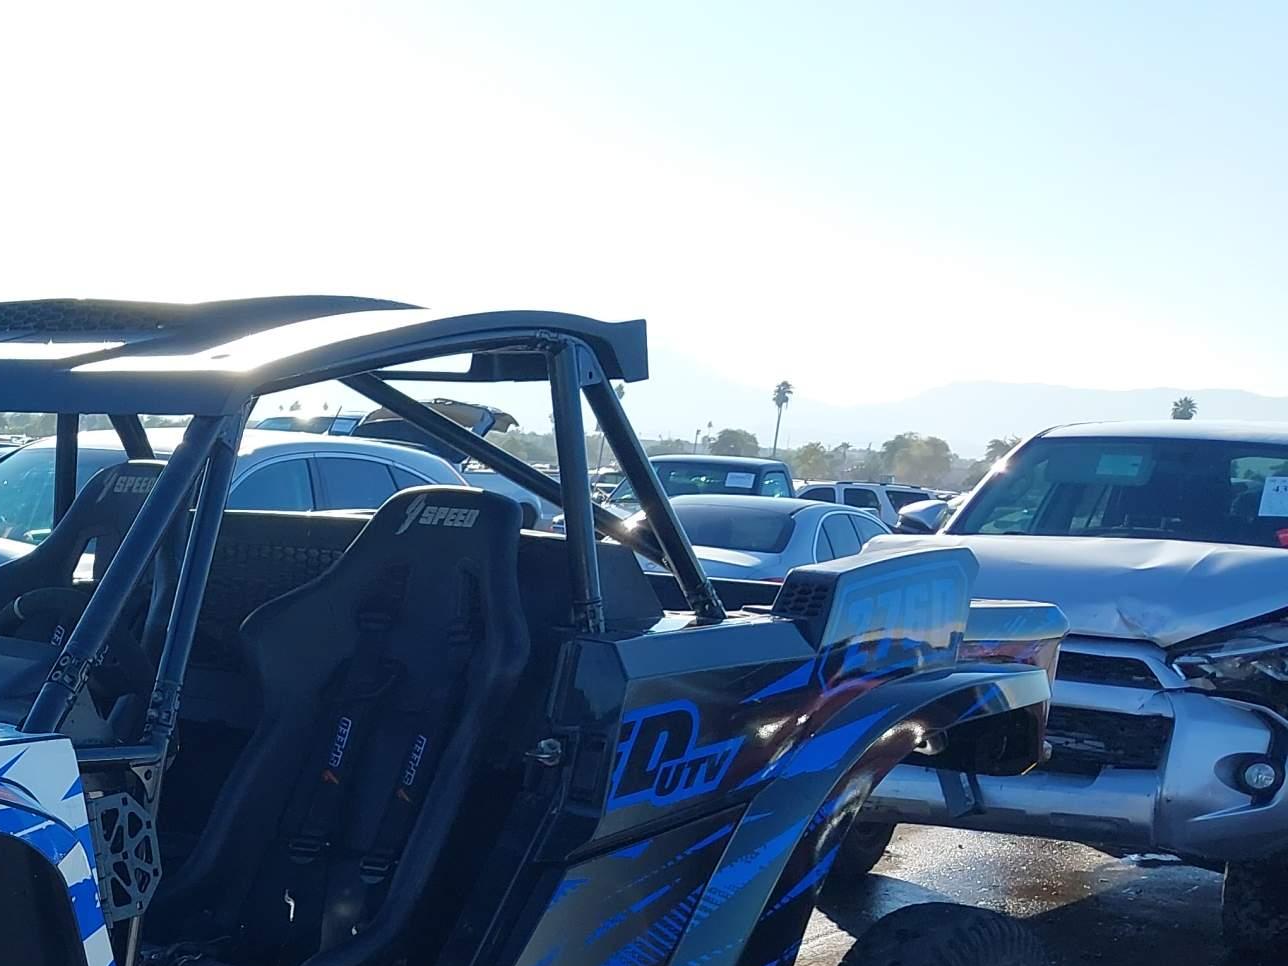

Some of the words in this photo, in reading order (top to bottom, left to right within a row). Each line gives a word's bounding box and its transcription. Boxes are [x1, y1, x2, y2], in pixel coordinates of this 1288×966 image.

[418, 506, 480, 528] SPEED
[328, 716, 352, 768] SPEED
[654, 747, 732, 798] UTV
